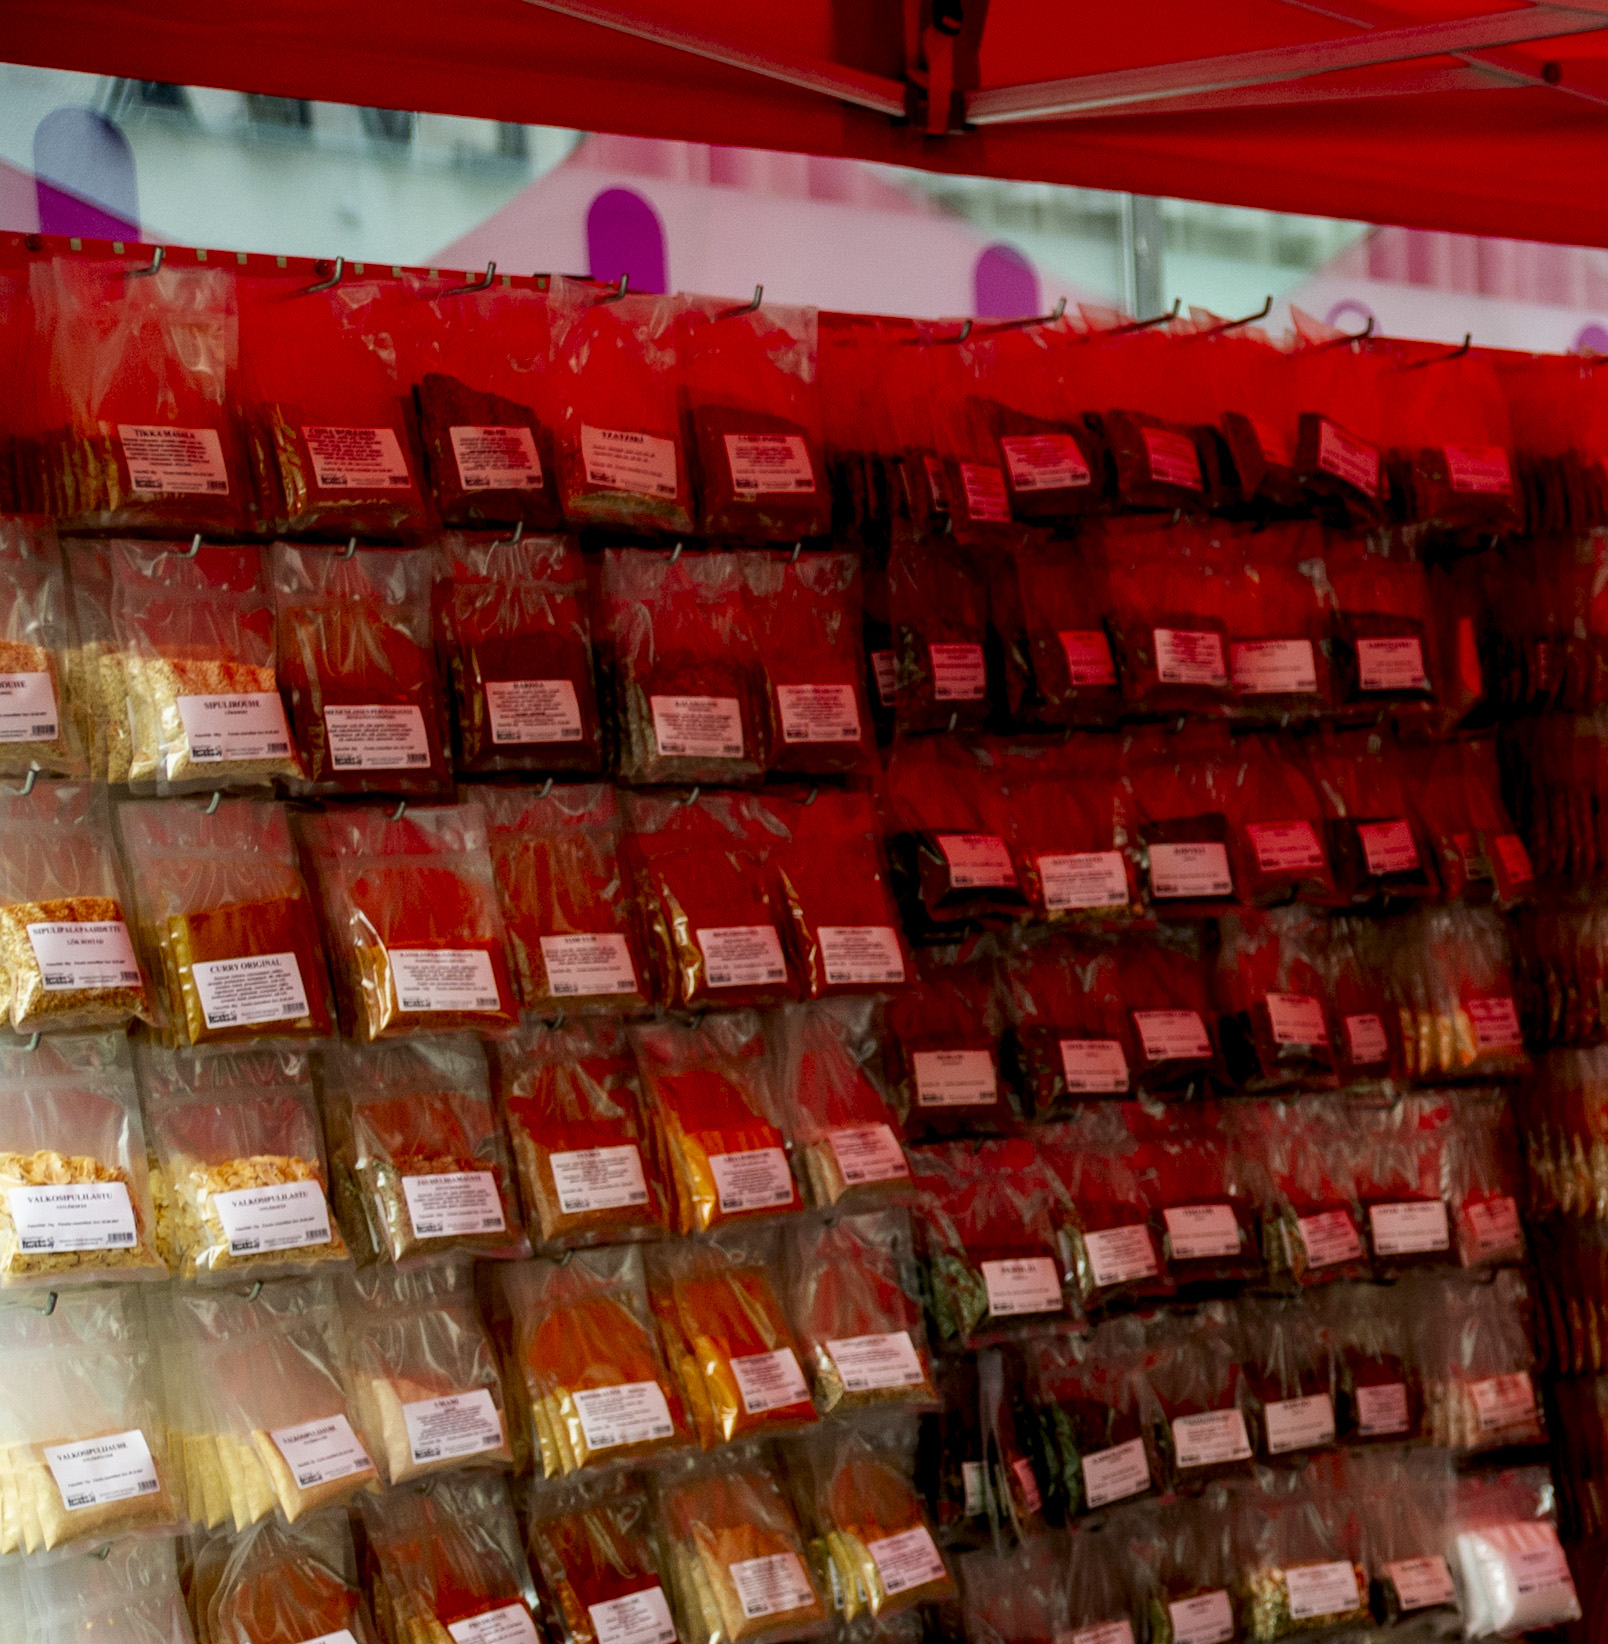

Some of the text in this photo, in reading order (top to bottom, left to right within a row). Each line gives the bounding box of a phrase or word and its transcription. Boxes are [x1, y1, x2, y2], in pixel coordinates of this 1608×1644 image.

[209, 958, 282, 975] CURRY ORIGINAL
[27, 1191, 113, 1204] VALKOSIPULILASTU
[231, 1190, 309, 1208] VALKOSIPULILASTU
[56, 1441, 128, 1461] VALKOSIPULIJAUHE
